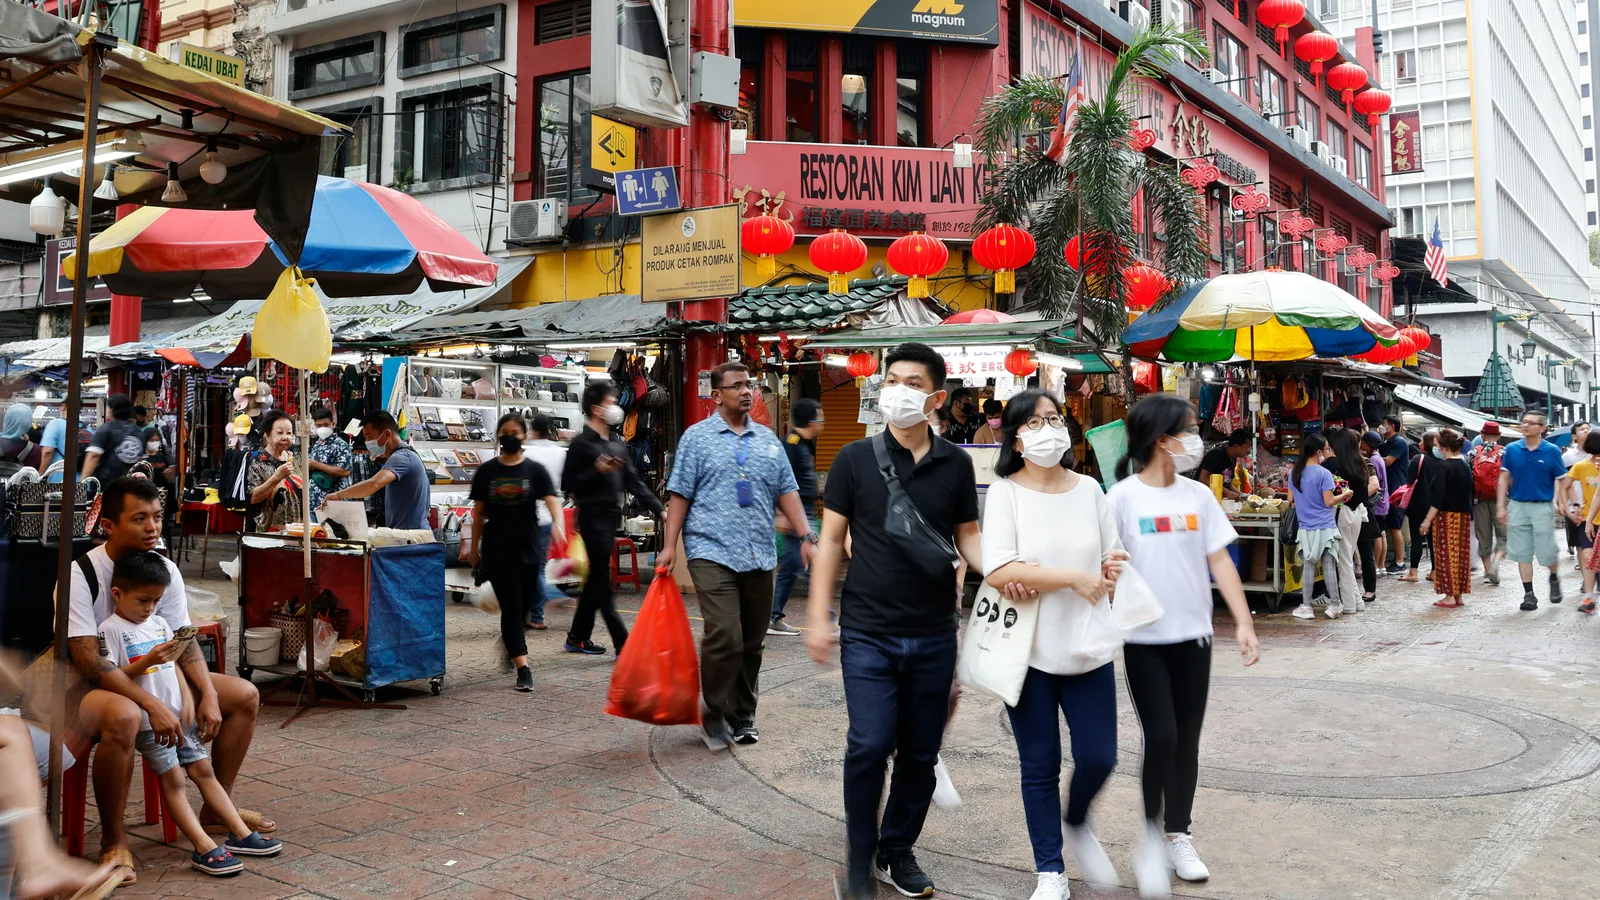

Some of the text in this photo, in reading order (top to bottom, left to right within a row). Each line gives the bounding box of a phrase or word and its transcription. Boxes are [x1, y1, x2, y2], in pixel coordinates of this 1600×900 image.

[911, 13, 965, 28] magnum
[185, 50, 238, 79] KEDAI UBAT
[1031, 12, 1092, 102] RESTORN
[800, 153, 884, 201] RESTORAN
[892, 159, 922, 203] KIM
[929, 161, 965, 204] LIAN
[653, 239, 726, 256] DILARANG MENJUAL
[646, 253, 734, 272] PRODUK CETAK ROMPAK
